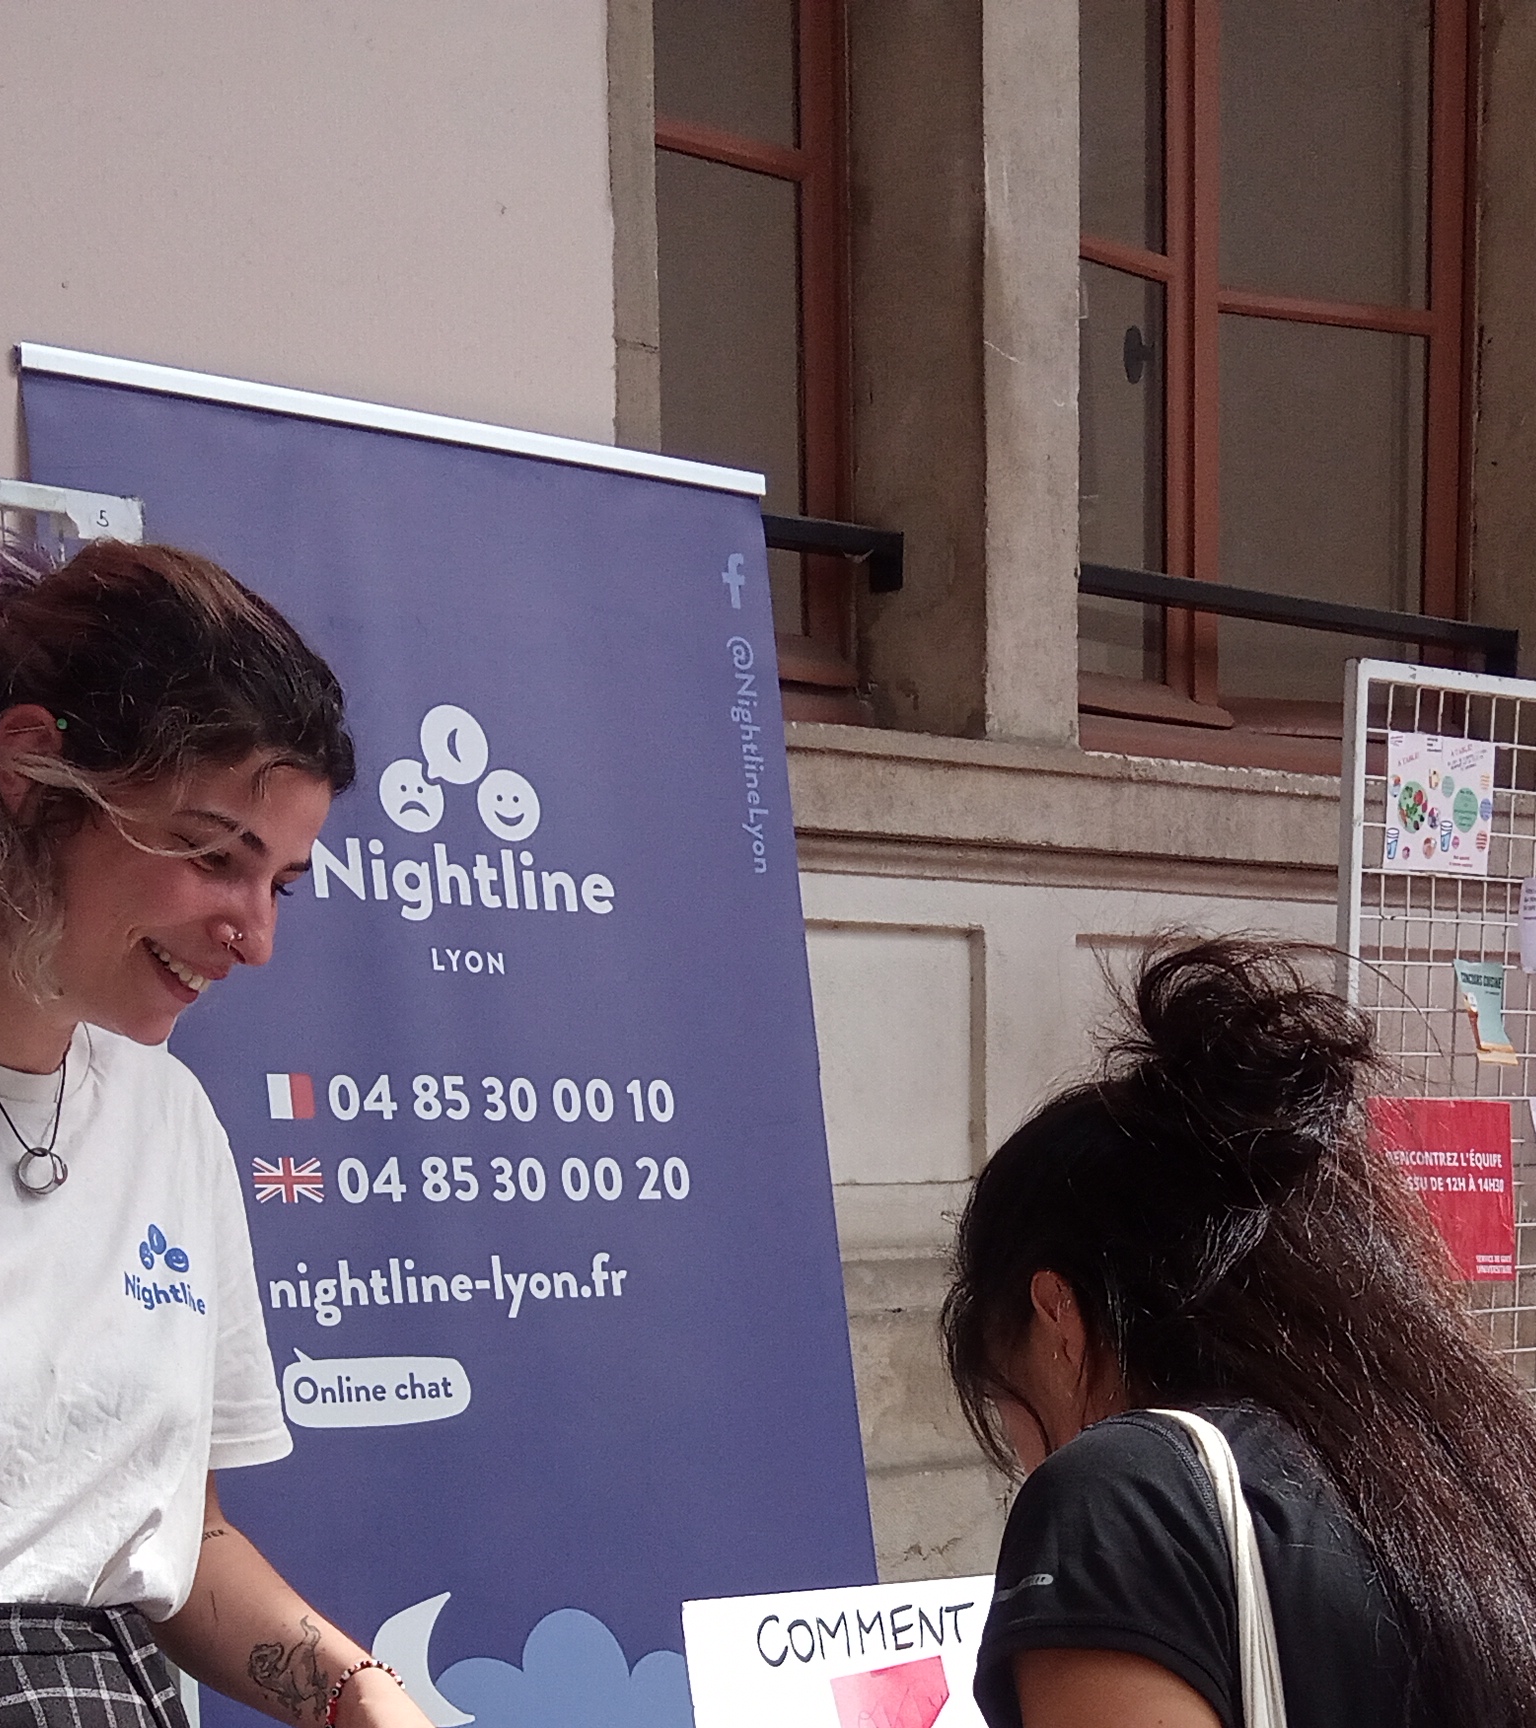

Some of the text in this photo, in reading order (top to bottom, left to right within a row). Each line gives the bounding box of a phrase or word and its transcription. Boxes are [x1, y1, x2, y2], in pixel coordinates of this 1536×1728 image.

[96, 509, 110, 528] 5
[725, 634, 770, 875] @NightlineLyon
[310, 837, 616, 921] Nightline
[430, 946, 507, 976] LYON
[327, 1073, 677, 1123] 04 85 30 00 10
[337, 1156, 692, 1204] 04 85 30 00 20
[1430, 1176, 1444, 1191] DE
[1445, 1176, 1465, 1192] 12H
[1468, 1173, 1477, 1192] À
[1460, 1148, 1503, 1171] L'ÉQUIPE
[123, 1271, 206, 1316] Nightline
[268, 1251, 629, 1327] nightline-lyon.fr
[292, 1372, 454, 1406] Online chat
[756, 1602, 975, 1668] COMMENT
